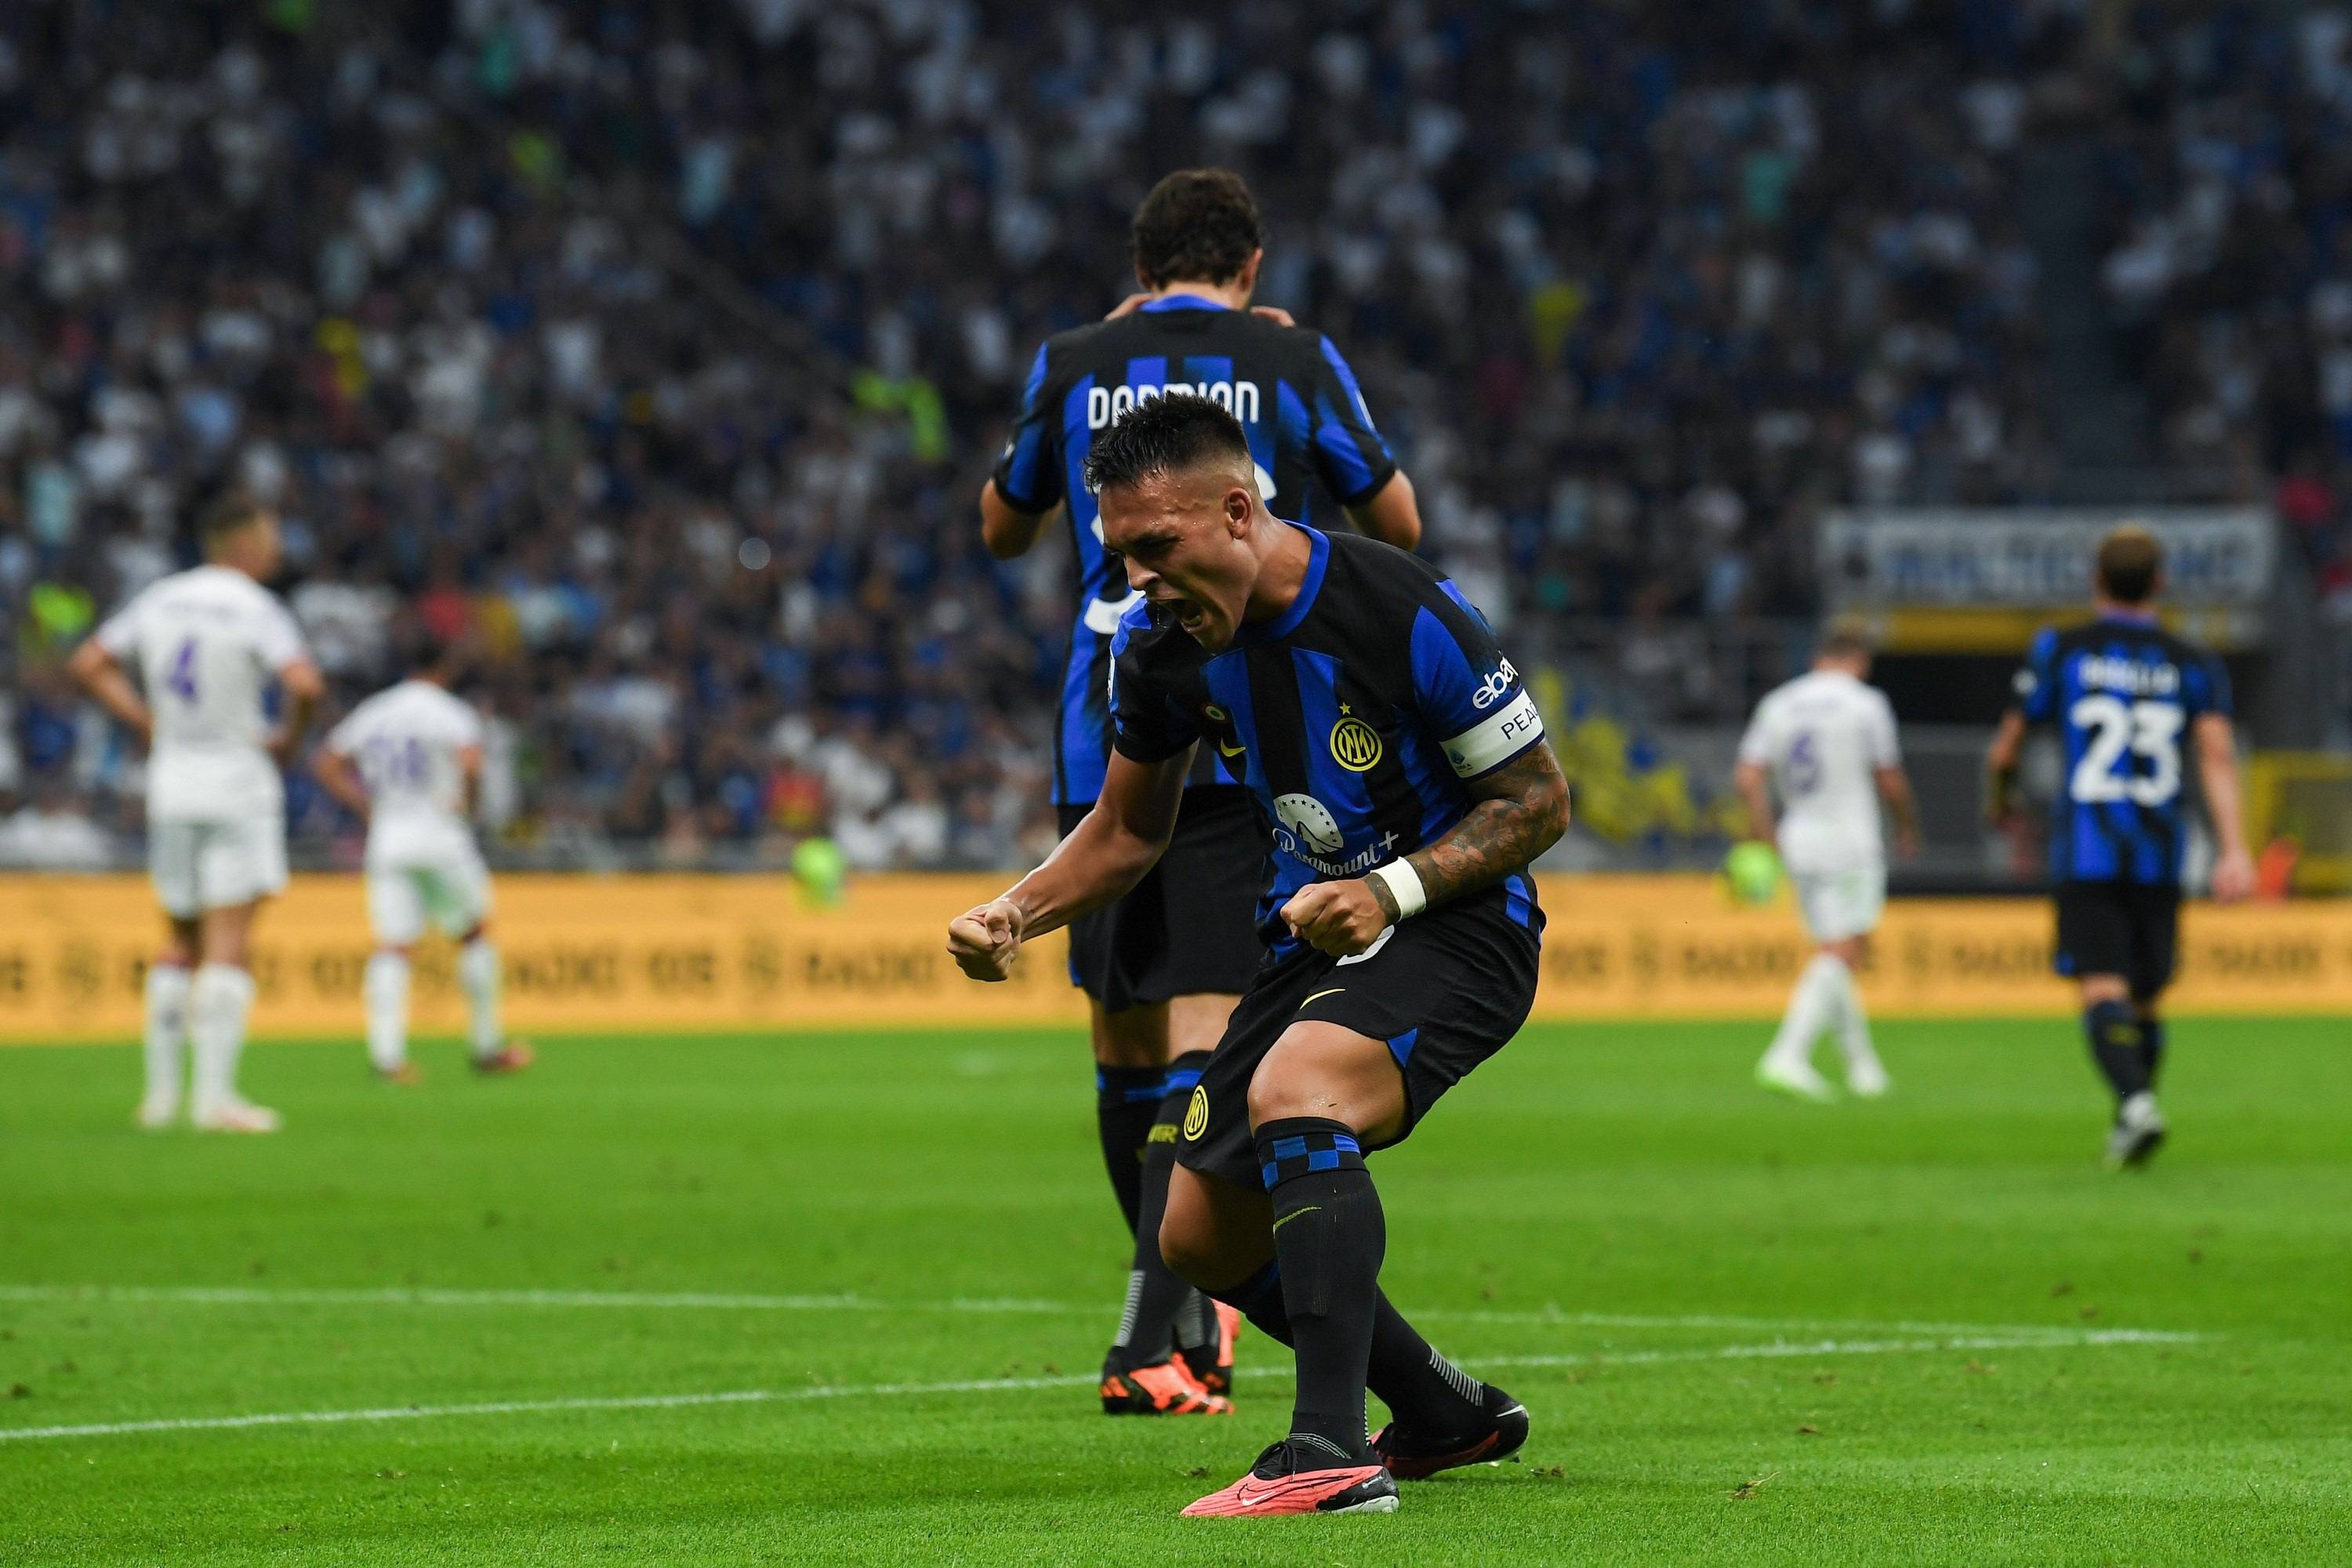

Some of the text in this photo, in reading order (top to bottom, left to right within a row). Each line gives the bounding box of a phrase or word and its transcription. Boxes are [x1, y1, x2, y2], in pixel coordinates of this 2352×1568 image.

[1087, 380, 1259, 430] DAAN
[167, 635, 201, 707] 4
[1472, 650, 1519, 710] eba
[2072, 697, 2184, 806] 23
